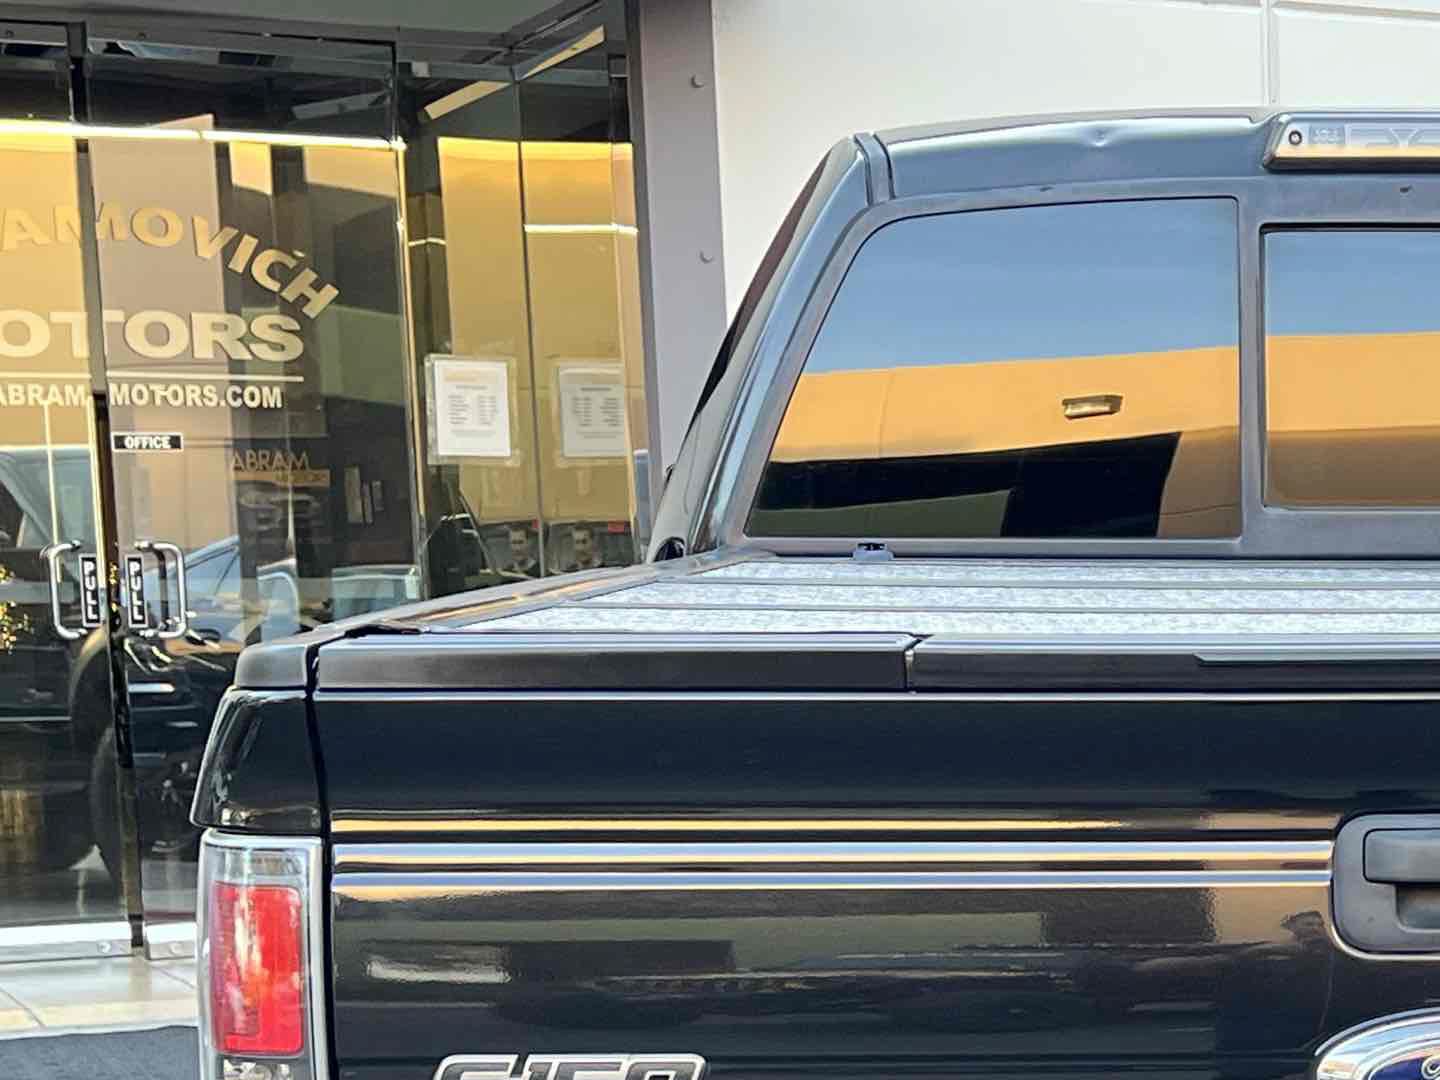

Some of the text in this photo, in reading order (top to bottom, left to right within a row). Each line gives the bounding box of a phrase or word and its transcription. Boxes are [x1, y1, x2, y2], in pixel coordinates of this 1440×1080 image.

[124, 436, 171, 449] OFFICE
[232, 450, 310, 471] ABRAM
[84, 561, 98, 620] PULL
[129, 561, 143, 620] PULL
